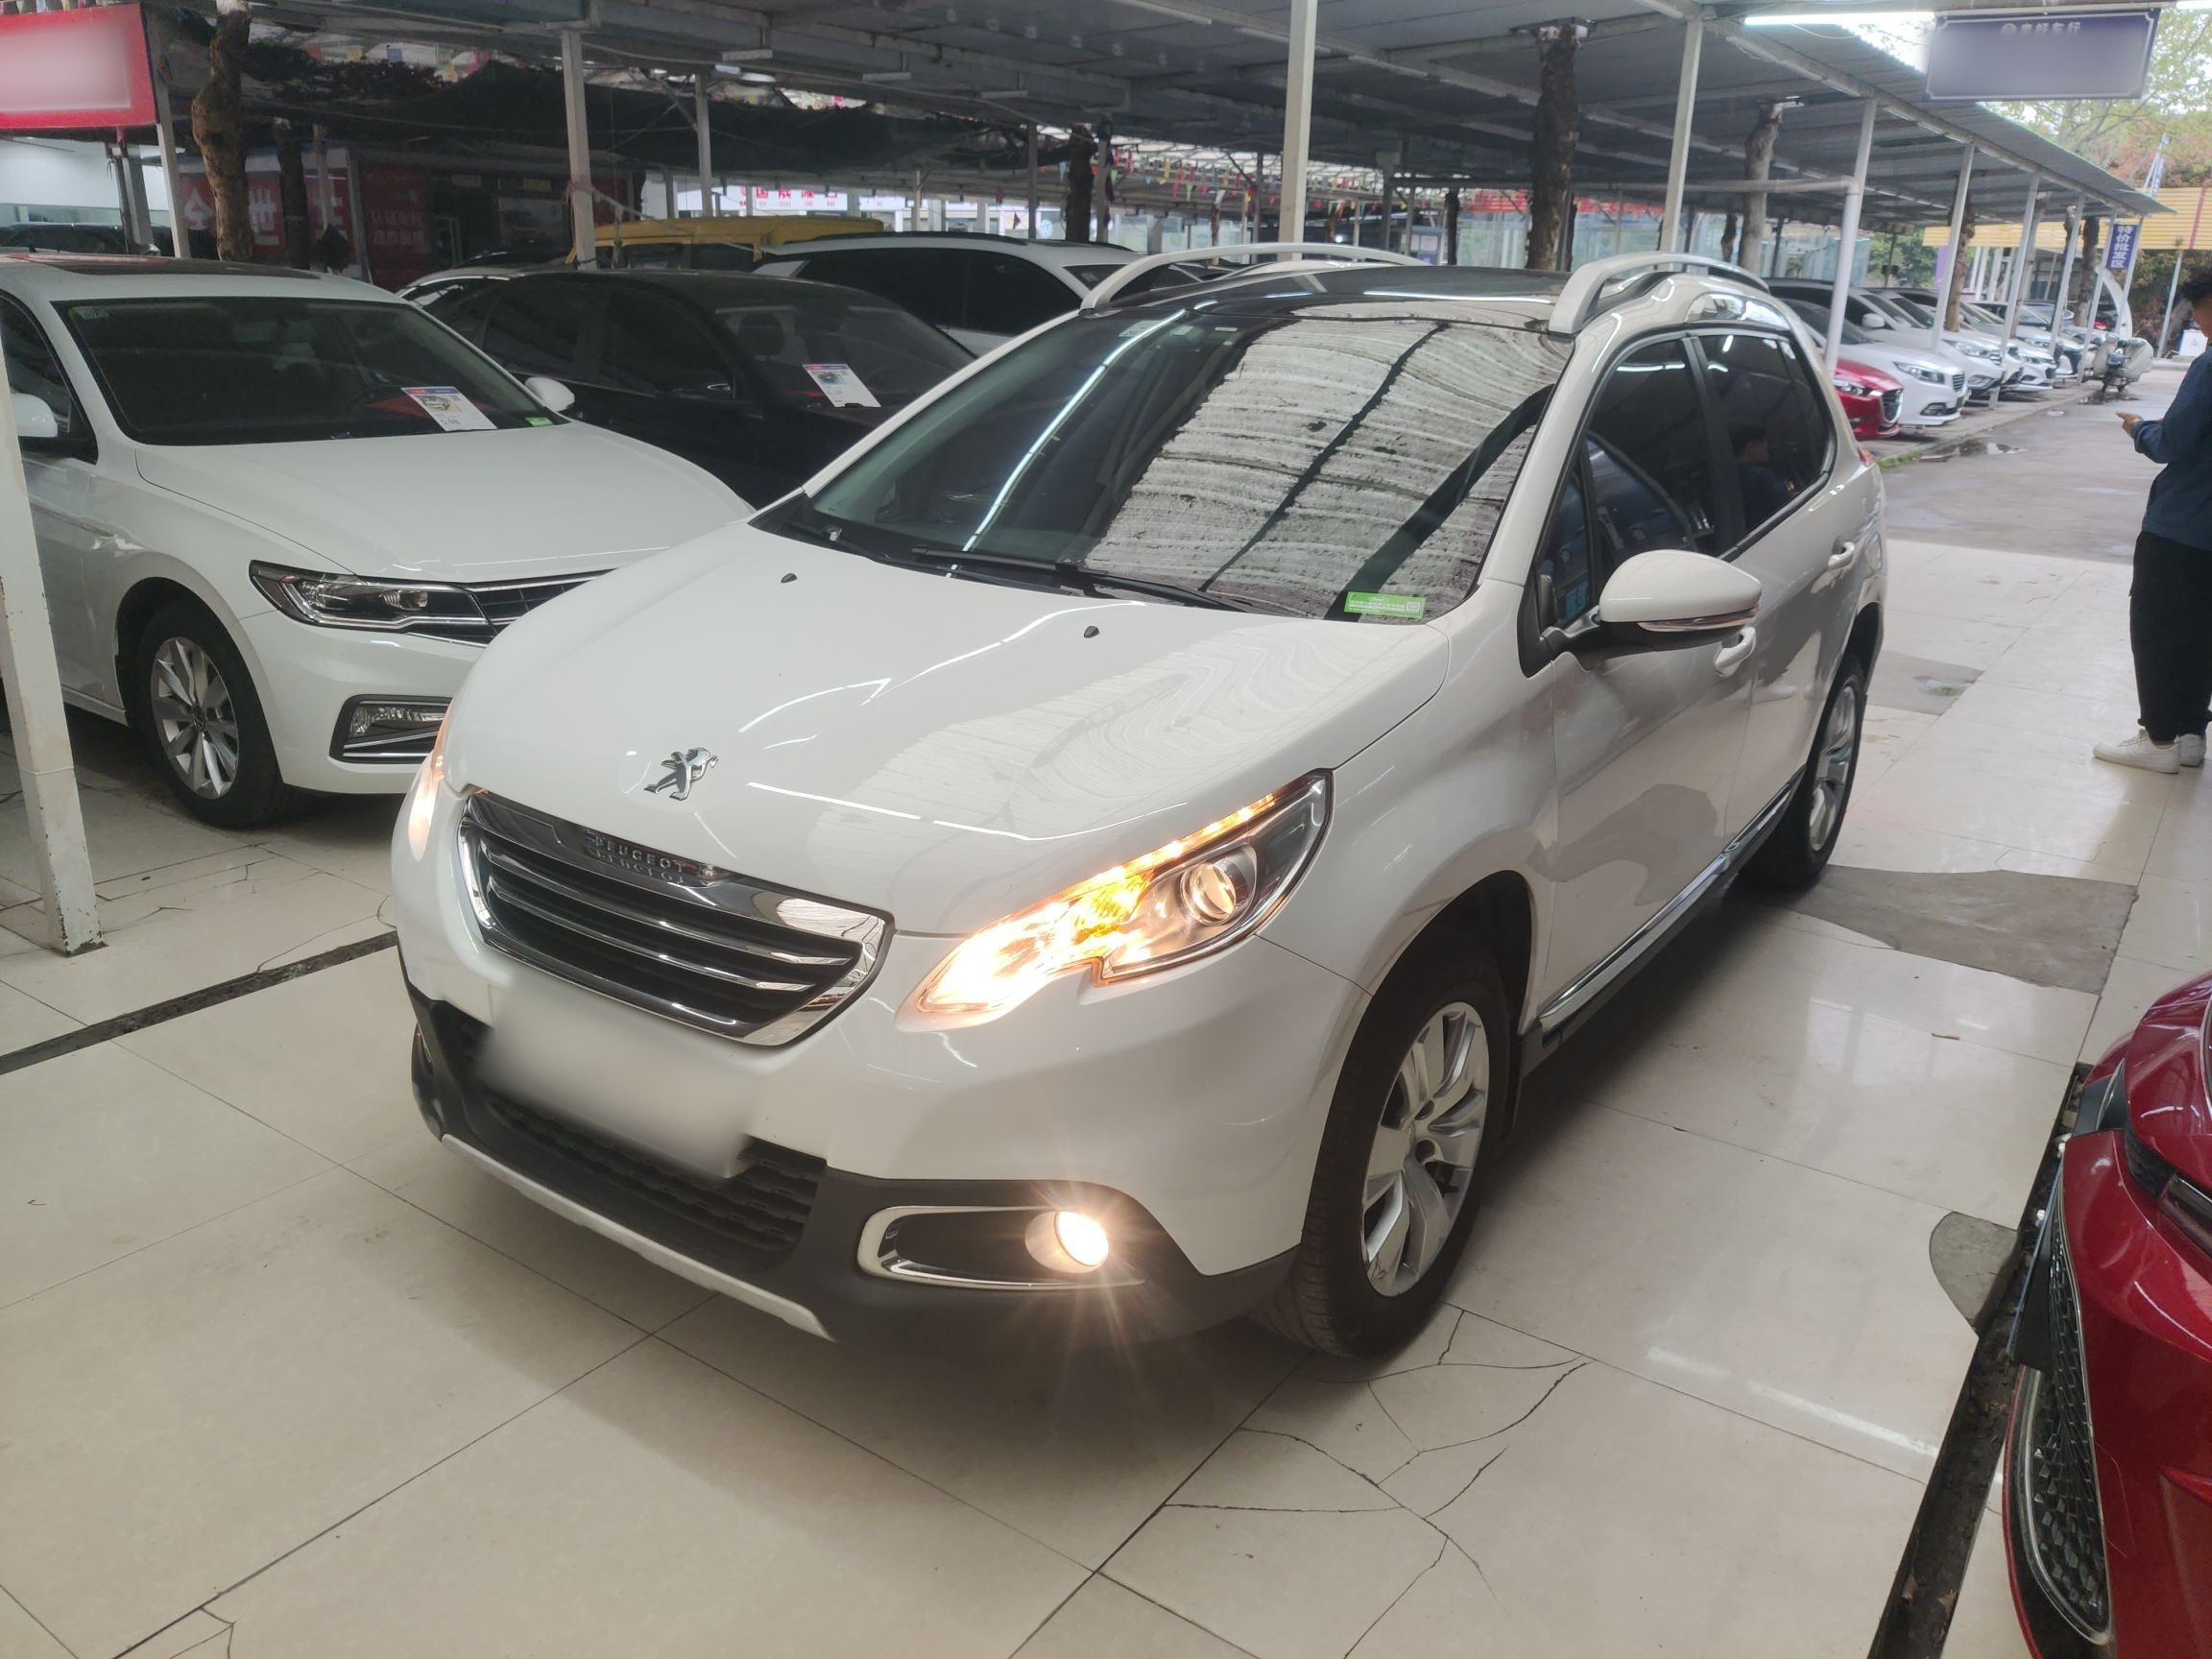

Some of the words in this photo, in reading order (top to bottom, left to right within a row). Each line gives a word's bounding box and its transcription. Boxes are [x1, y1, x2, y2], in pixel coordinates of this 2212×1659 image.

[2110, 225, 2134, 269] 特价批发区
[594, 835, 683, 873] PEUGEOT
